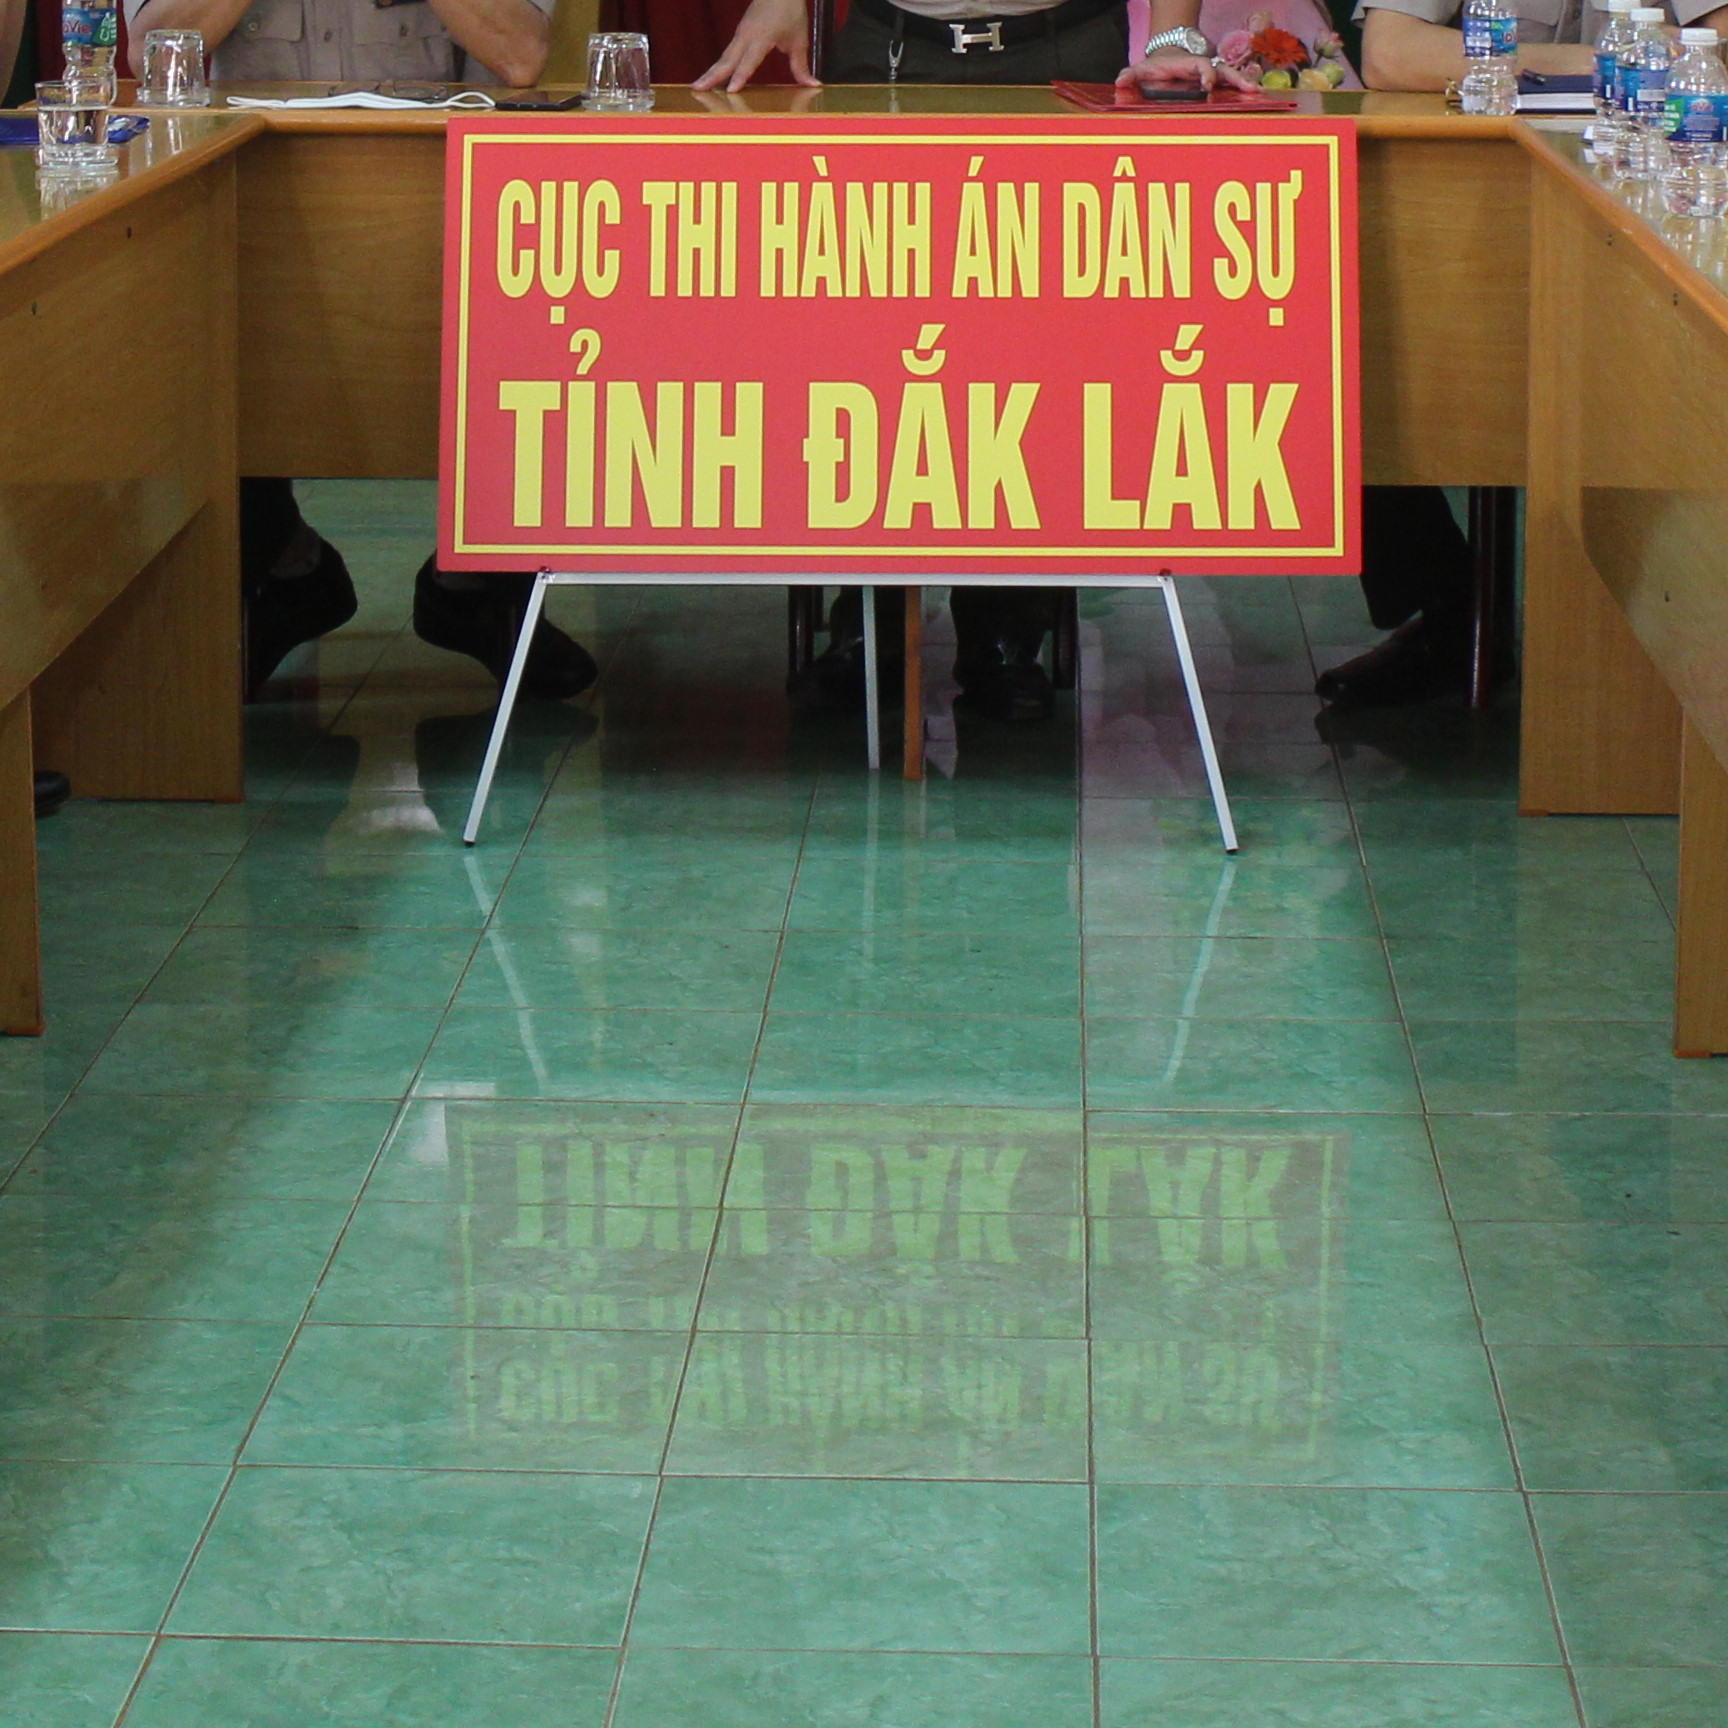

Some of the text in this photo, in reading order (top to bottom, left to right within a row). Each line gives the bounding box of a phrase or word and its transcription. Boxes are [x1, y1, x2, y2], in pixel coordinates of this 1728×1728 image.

[497, 155, 1302, 327] CỤC THI HÀNH ÁN DÂN SỰ
[499, 324, 1301, 531] TỈNH ĐẮK LẮK
